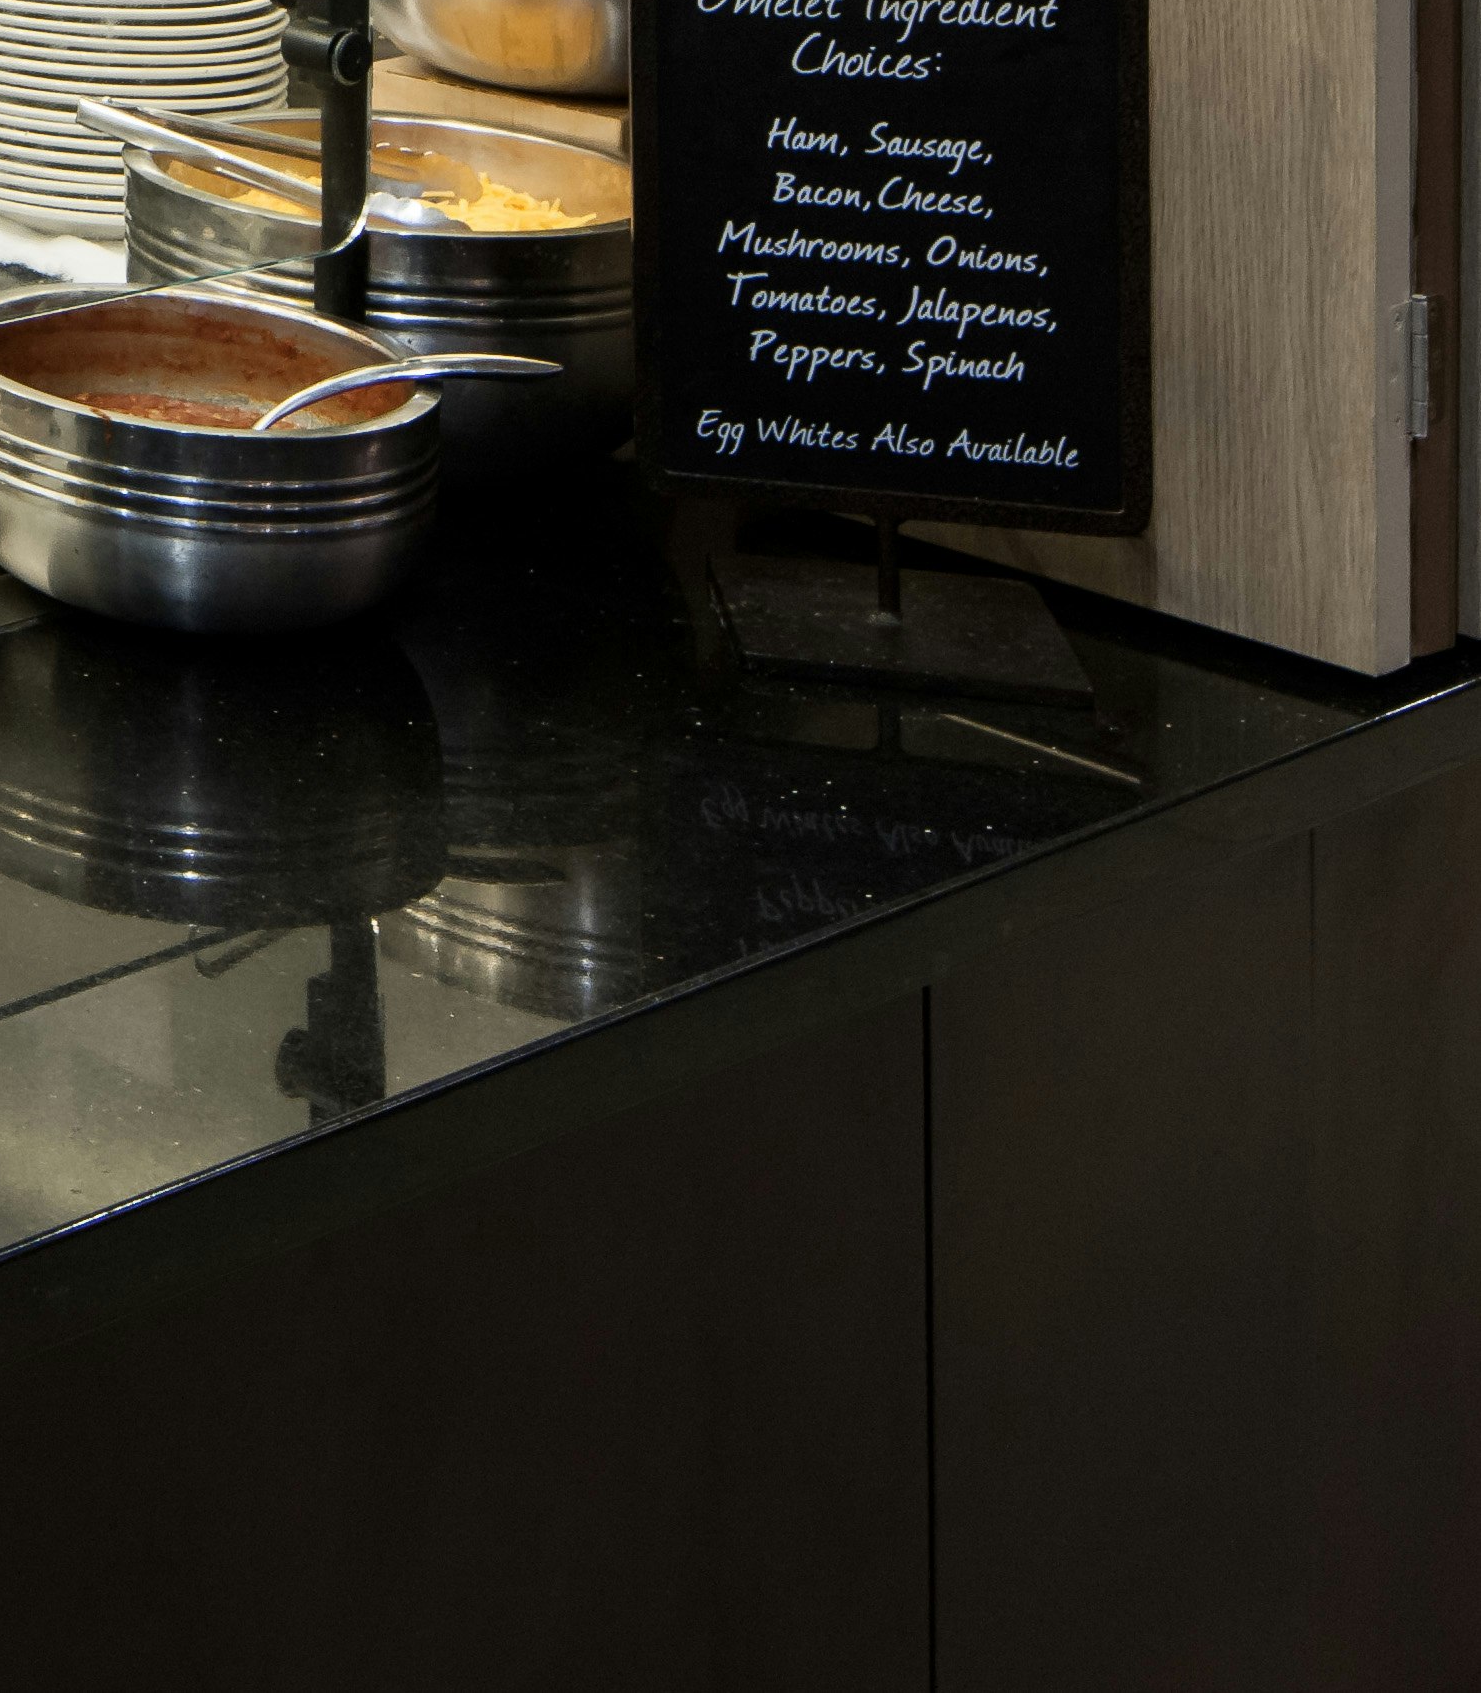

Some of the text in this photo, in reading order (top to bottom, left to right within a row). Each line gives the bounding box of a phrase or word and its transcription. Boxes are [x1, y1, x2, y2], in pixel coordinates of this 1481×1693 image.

[792, 32, 941, 79] Choices:
[768, 117, 992, 175] Ham, Sausage,
[773, 172, 992, 219] Bacon, Cheese,
[718, 221, 1047, 277] Mushrooms, Onions,
[727, 272, 1056, 339] Tomatoes, Jalapenos,
[750, 330, 1024, 390] Peppers, Spinach
[697, 410, 1078, 468] Egg Whites Also Available
